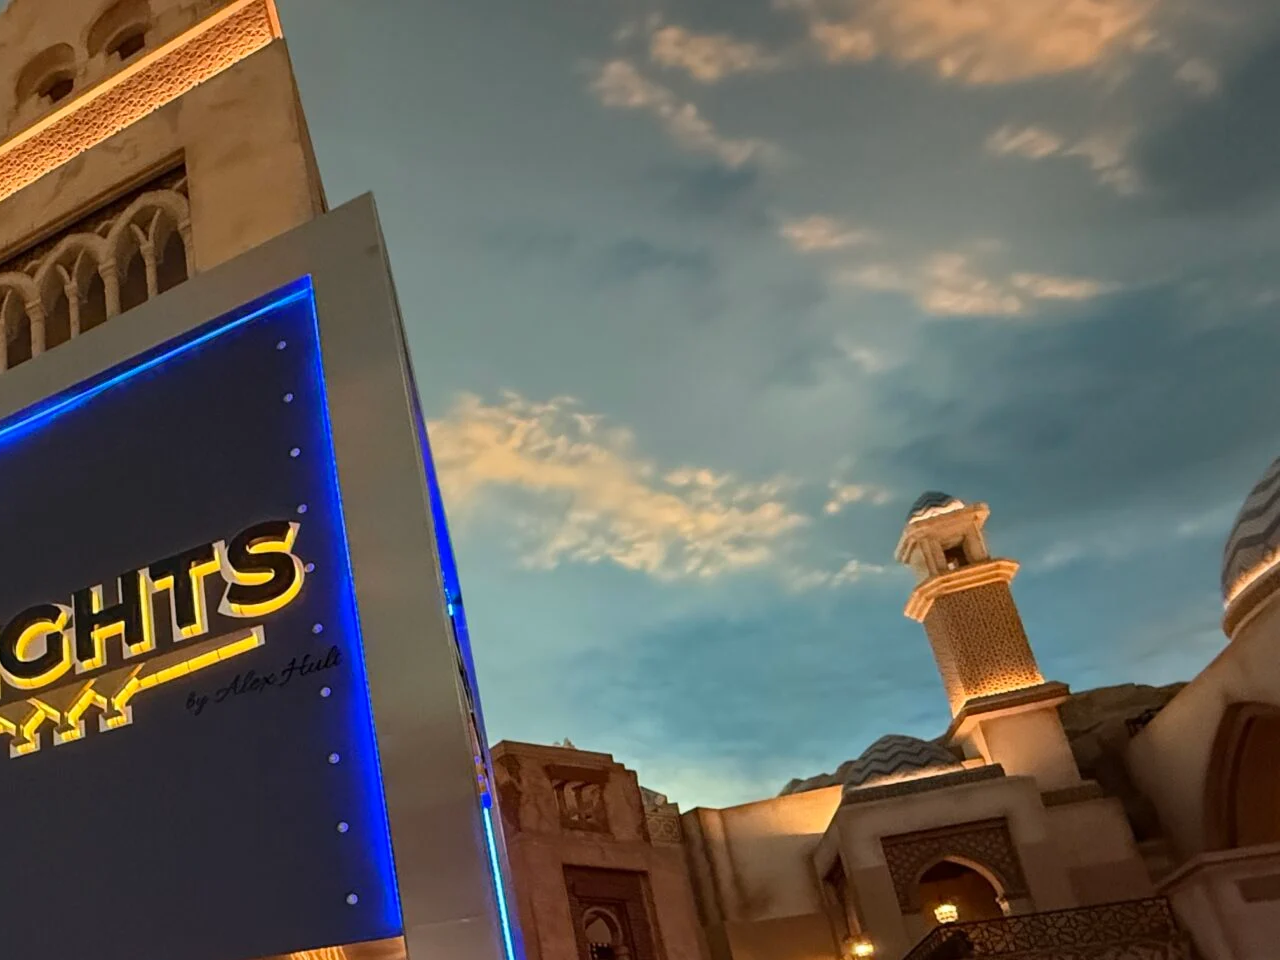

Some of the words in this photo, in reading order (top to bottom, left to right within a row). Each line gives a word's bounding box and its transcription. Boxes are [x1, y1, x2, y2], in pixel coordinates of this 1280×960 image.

[185, 691, 208, 716] by
[216, 669, 276, 704] Alex
[278, 645, 343, 686] Hult
